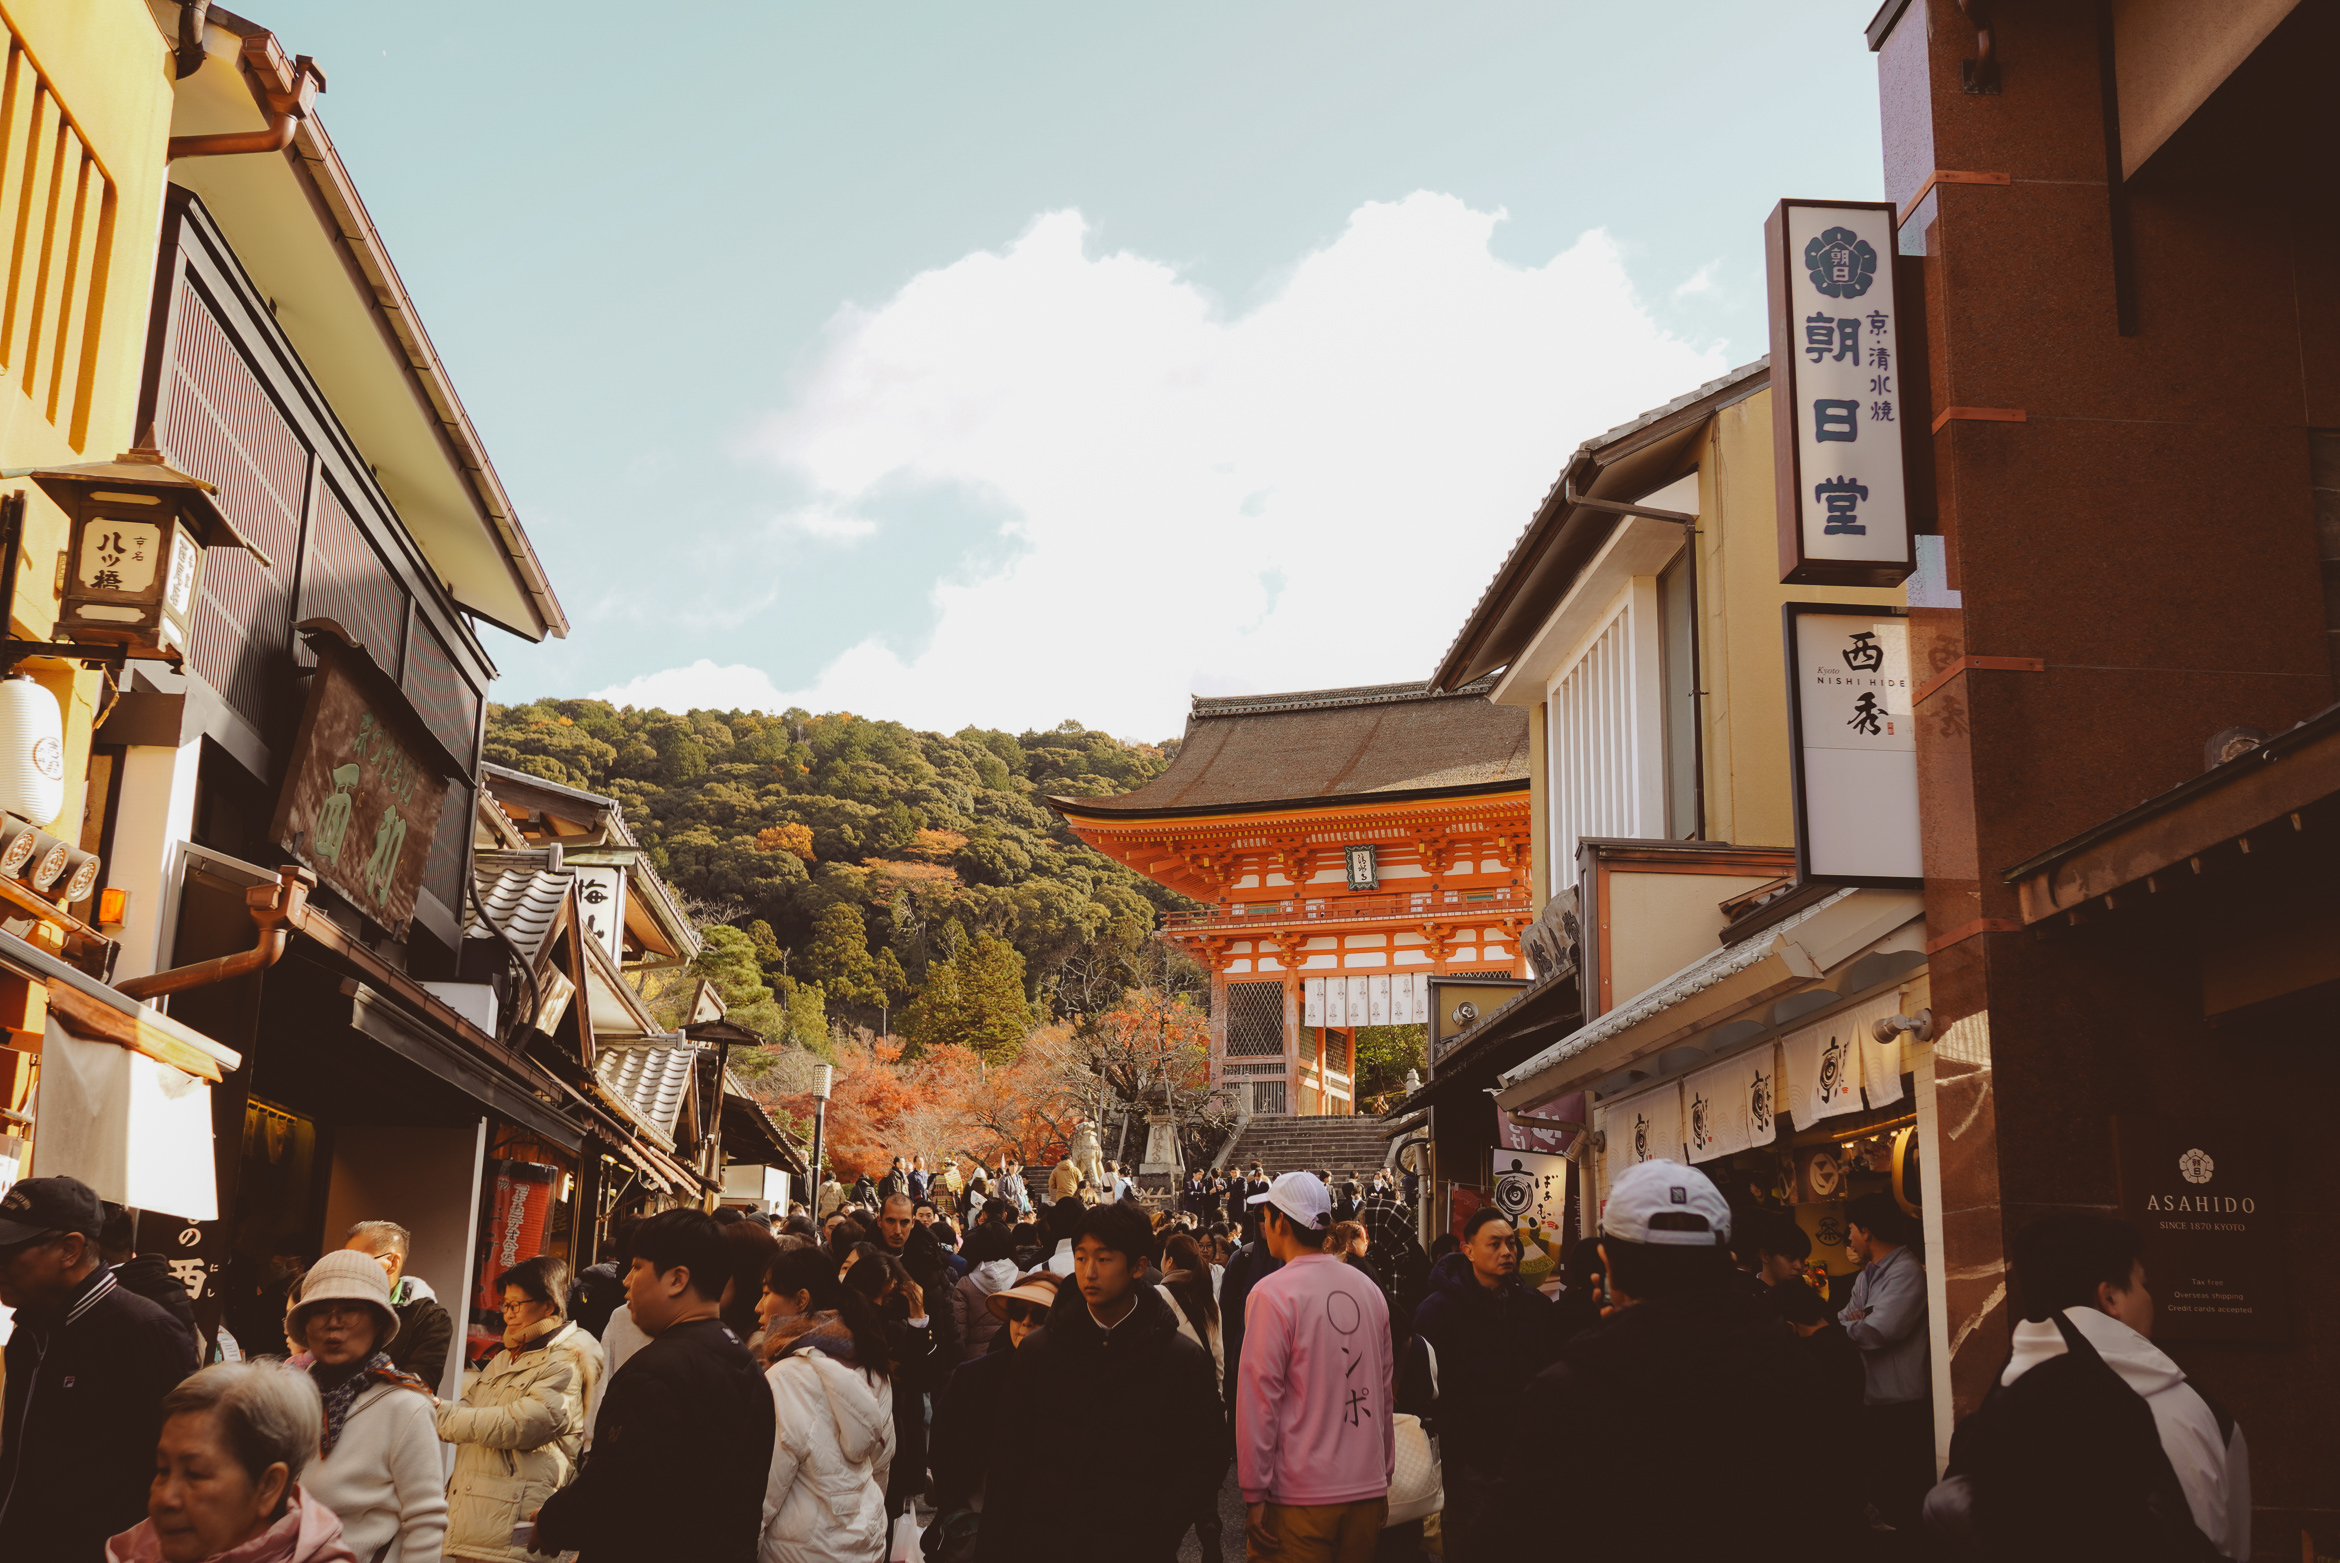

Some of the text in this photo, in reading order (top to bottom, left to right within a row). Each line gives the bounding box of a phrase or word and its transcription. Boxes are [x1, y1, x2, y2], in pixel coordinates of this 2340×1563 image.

[1805, 311, 1869, 536] 朝日堂
[1817, 666, 1840, 675] Kyoto
[1817, 677, 1905, 688] NISHI HIDE
[2147, 1194, 2255, 1214] ASAHIDO
[2160, 1221, 2245, 1232] SINCE 1870 KYOTO
[2192, 1278, 2205, 1286] Tax
[2174, 1291, 2244, 1301] Overseas shipping
[2168, 1304, 2253, 1314] Credit cards accepted
